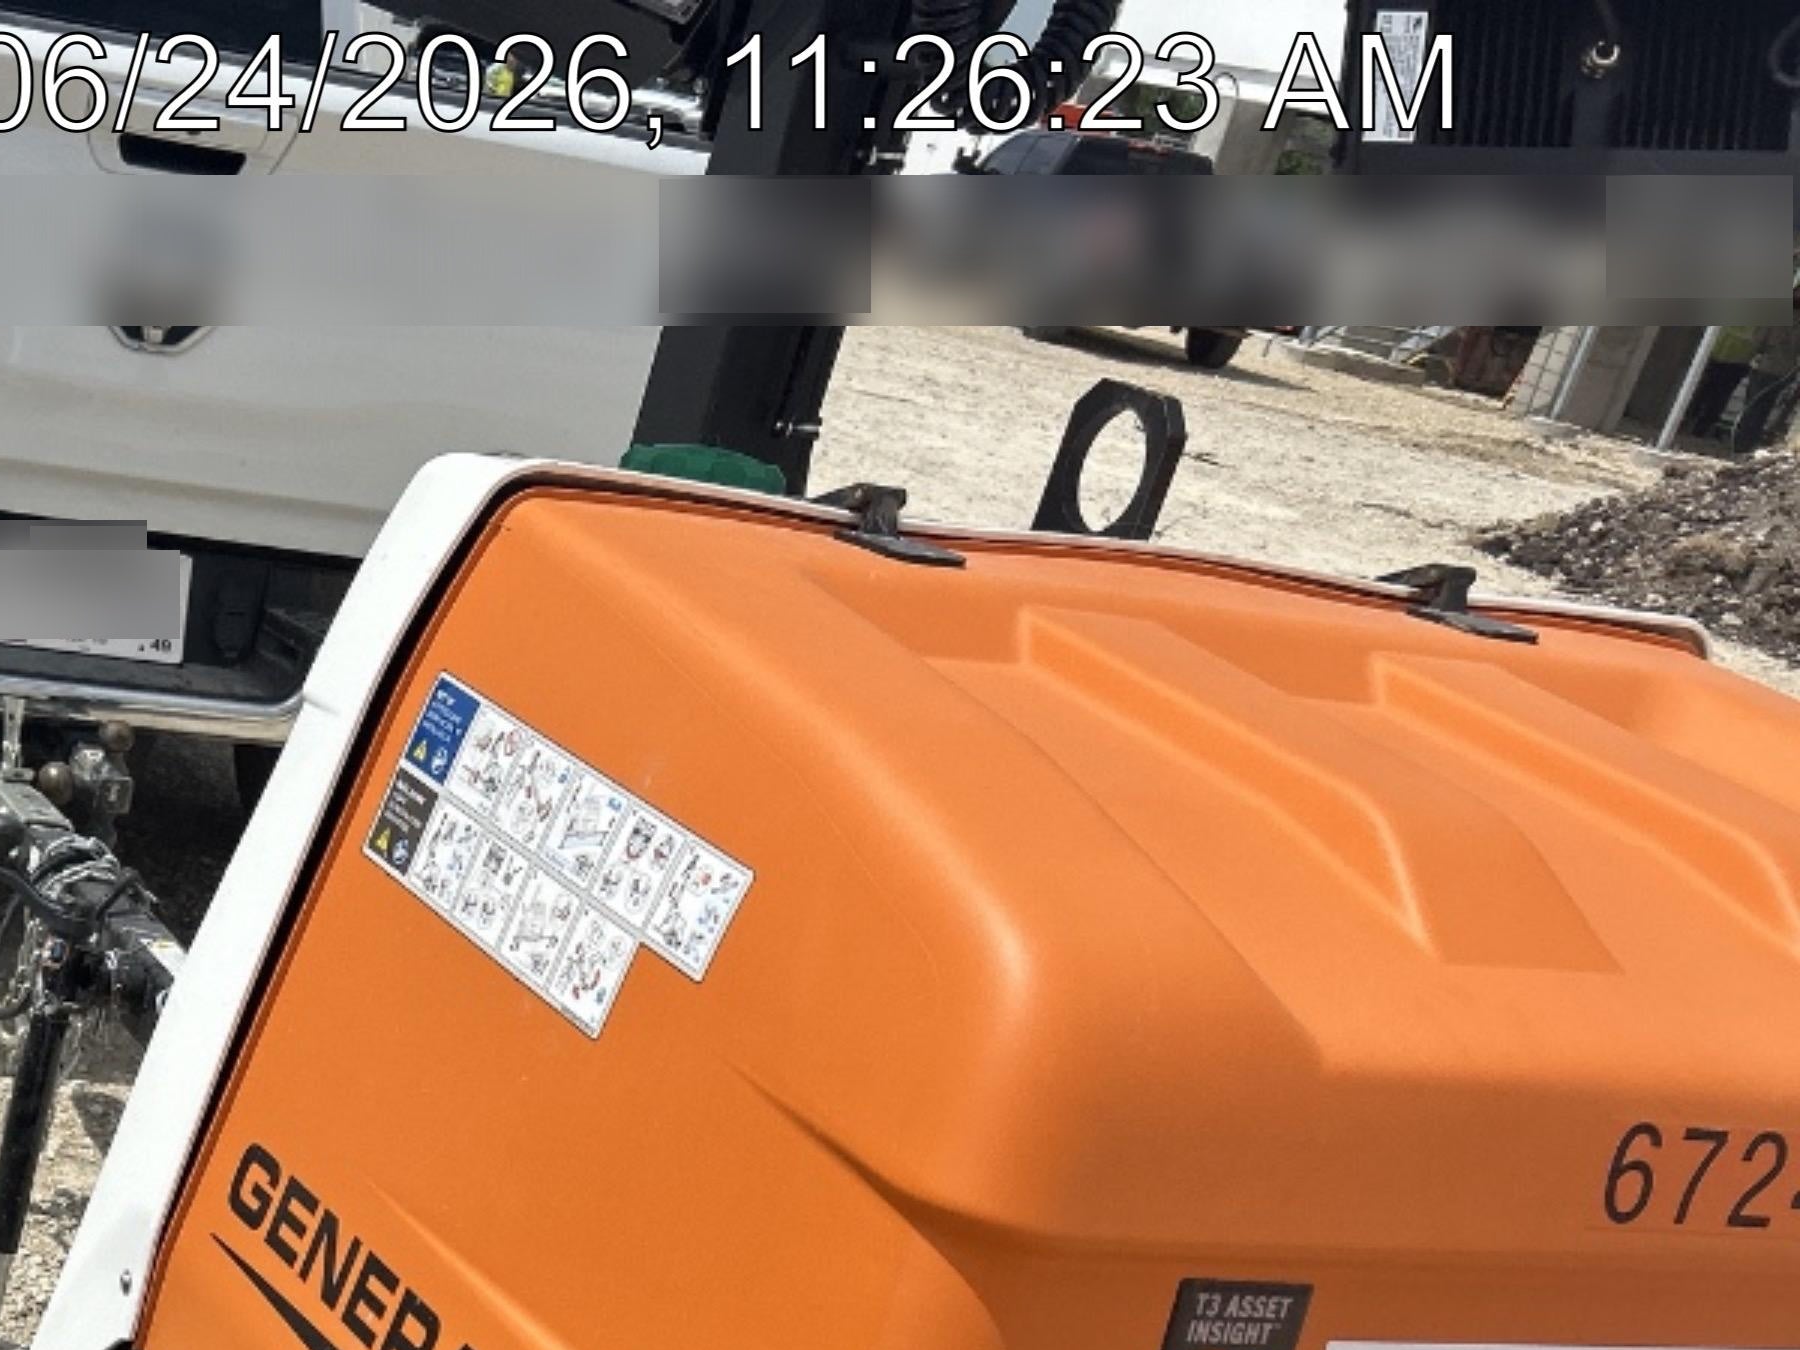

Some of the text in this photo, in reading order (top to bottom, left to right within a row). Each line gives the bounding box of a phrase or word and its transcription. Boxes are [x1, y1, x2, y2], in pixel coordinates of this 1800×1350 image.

[1604, 1121, 1800, 1228] 672
[1195, 1292, 1294, 1319] T3 ASSET
